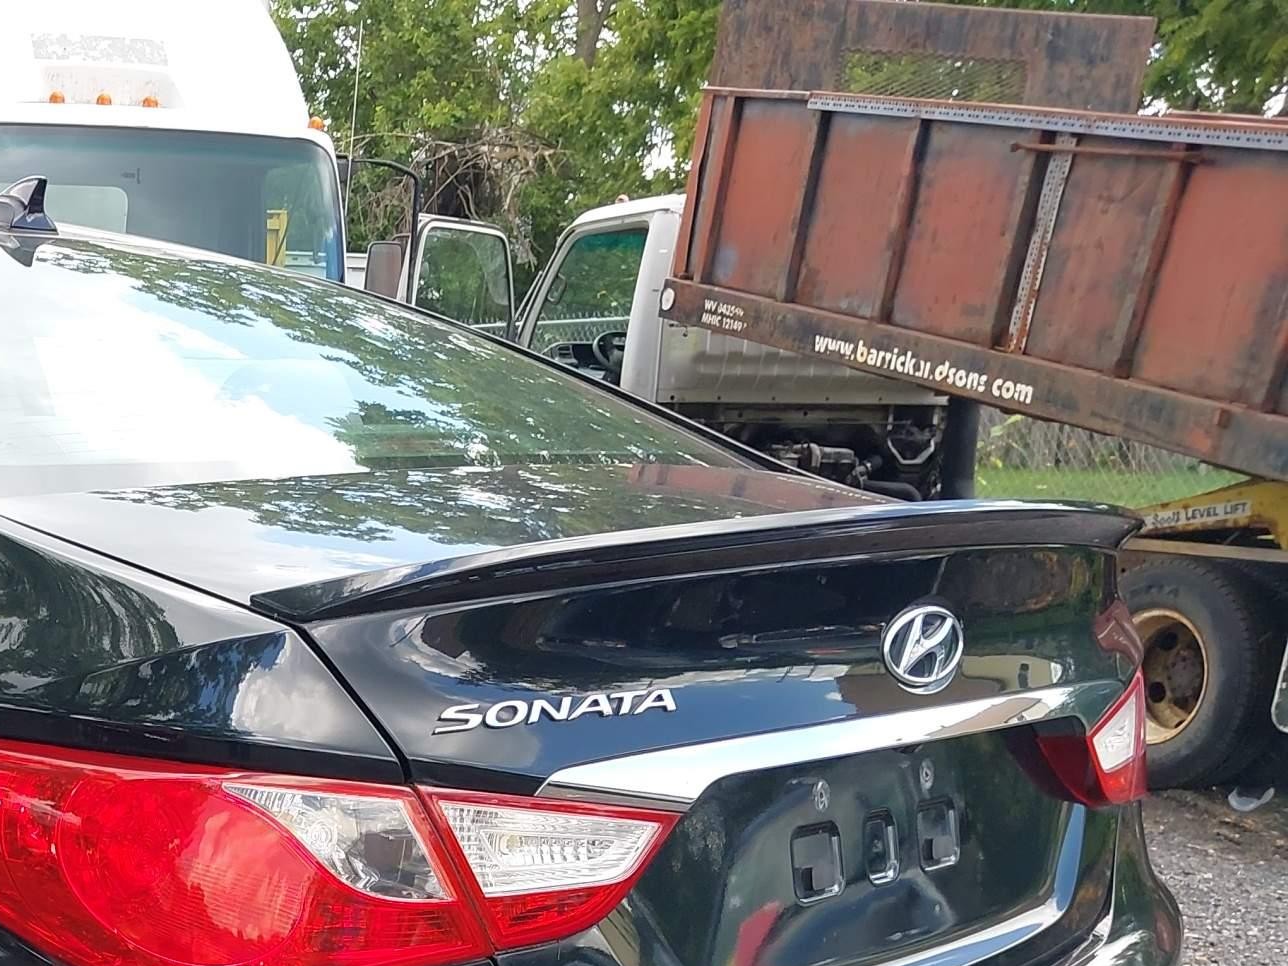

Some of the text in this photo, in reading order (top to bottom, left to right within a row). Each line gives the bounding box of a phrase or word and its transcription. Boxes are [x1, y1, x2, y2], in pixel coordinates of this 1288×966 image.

[704, 299, 718, 312] WV
[1185, 506, 1218, 521] LEVEL
[1223, 502, 1249, 515] LIFT
[433, 688, 677, 735] SONATA
